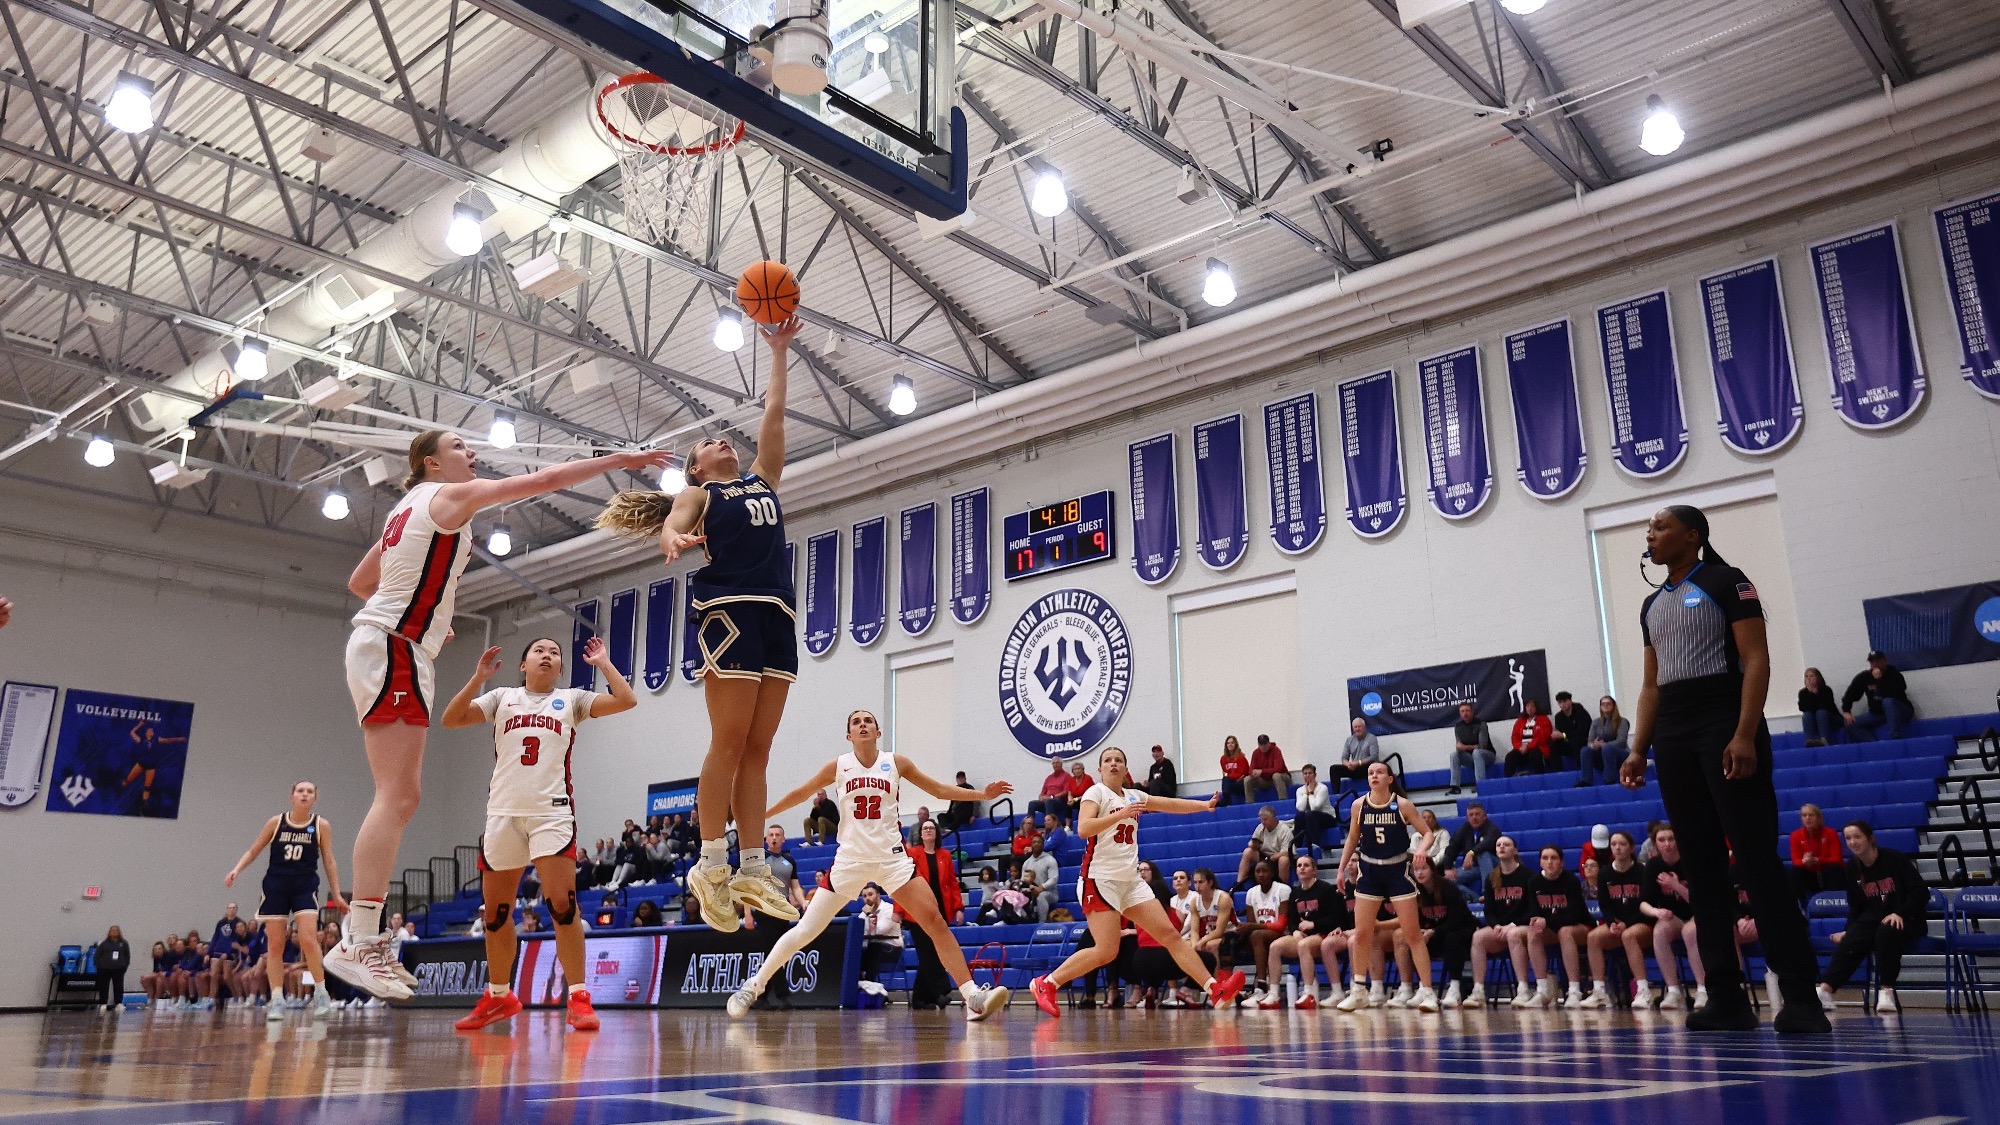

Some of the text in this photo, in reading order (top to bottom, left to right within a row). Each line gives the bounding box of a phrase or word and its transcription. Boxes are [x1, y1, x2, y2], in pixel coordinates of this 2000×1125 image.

[1635, 438, 1663, 449] WOMEN'S
[745, 497, 778, 526] 00
[1042, 501, 1078, 526] 4:18
[1010, 519, 1103, 551] HOME PERIOD GUEST
[1018, 531, 1105, 571] 17 1 9
[1024, 619, 1059, 659] GO GENERALS
[1066, 617, 1100, 642] BLEED BLUE
[1001, 592, 1128, 729] OLD DOMINION ATHLETIC CONFERENCE
[1019, 666, 1036, 714] RESPECT ALL
[1081, 645, 1107, 721] GENERALS WIN DAY
[1391, 683, 1477, 707] DIVISION III
[76, 703, 162, 722] VOLLEYBALL
[1363, 703, 1382, 711] NCAA
[1392, 705, 1418, 713] DISCOVER
[1422, 702, 1446, 710] DEVELOP
[504, 714, 561, 736] DENISON
[1037, 715, 1076, 730] CHEER HARD
[521, 736, 540, 765] 3
[1046, 739, 1082, 754] ODAC
[846, 777, 891, 794] DENISON
[653, 793, 695, 811] CHAMPIONS
[853, 796, 881, 819] 32
[1364, 812, 1396, 825] JOHN CARROLL
[1375, 827, 1385, 844] 5
[284, 844, 304, 861] 30
[413, 950, 819, 996] GENERAL ATHLECS
